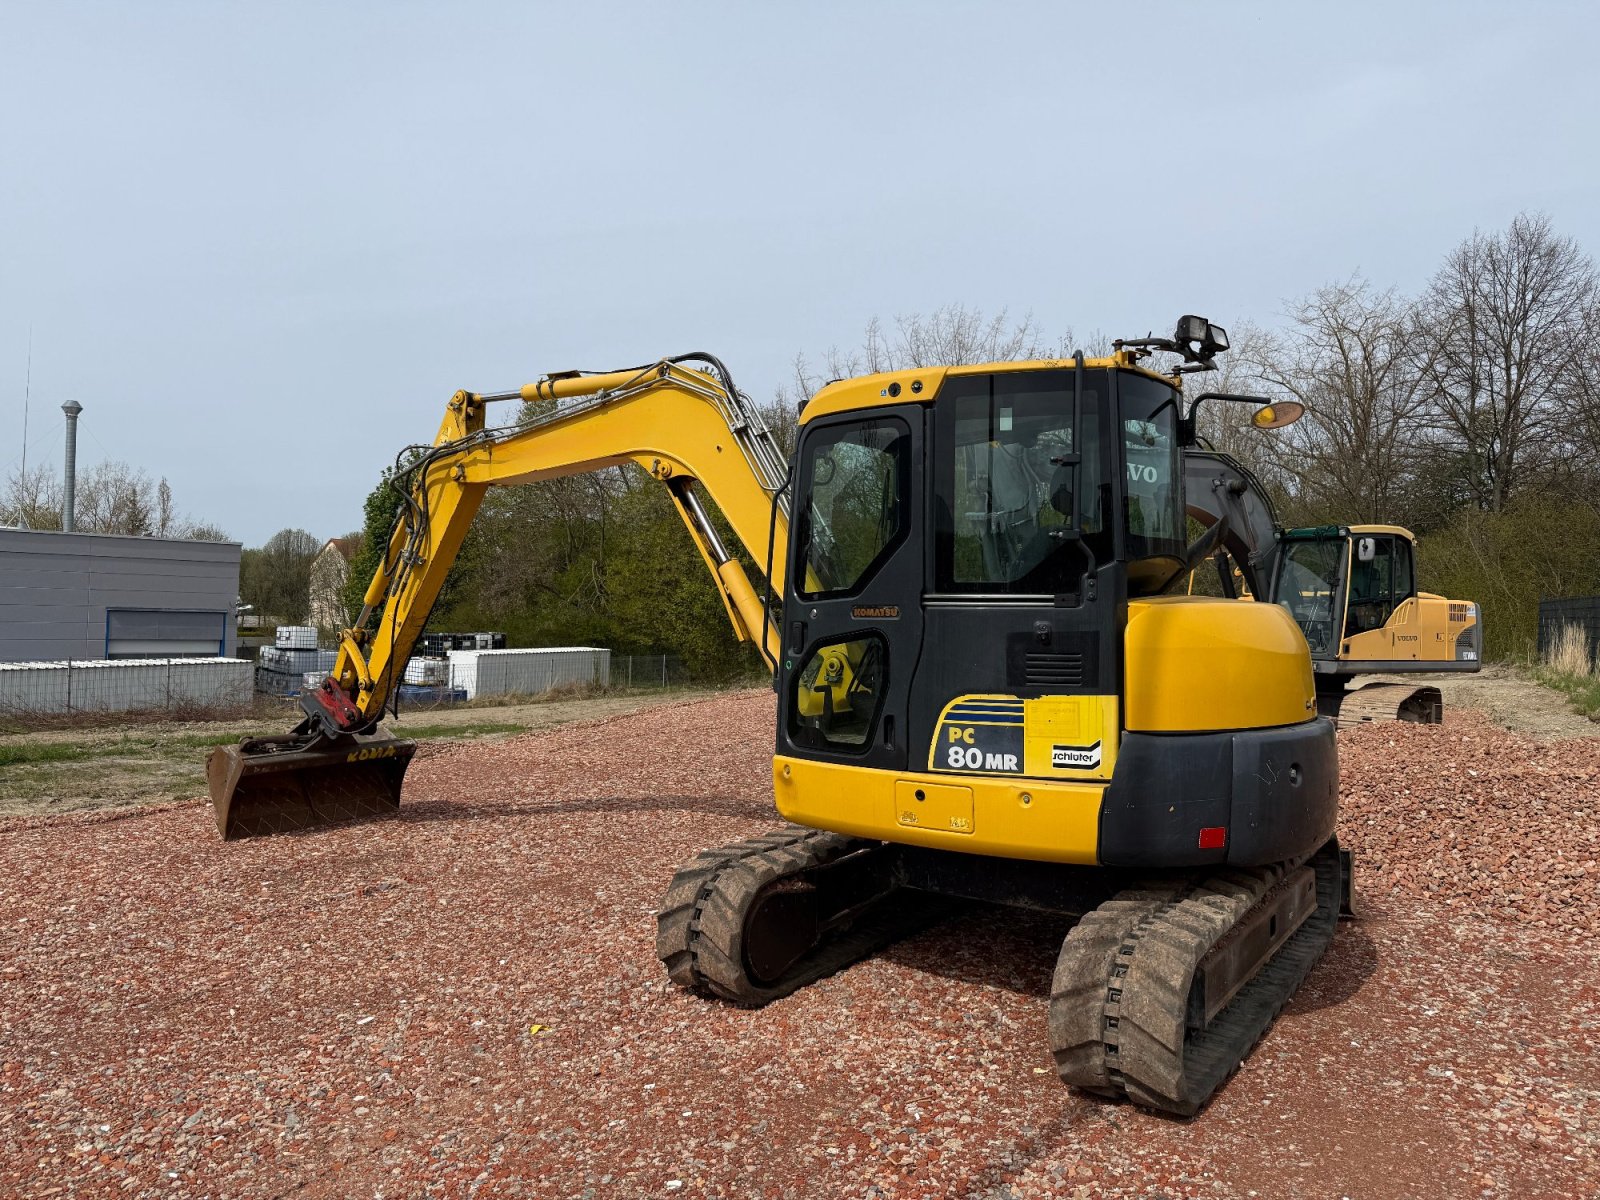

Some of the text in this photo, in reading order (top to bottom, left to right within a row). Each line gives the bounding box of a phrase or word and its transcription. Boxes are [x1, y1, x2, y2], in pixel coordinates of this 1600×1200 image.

[1127, 462, 1158, 483] VO
[854, 608, 898, 617] KOMATSU
[948, 726, 975, 744] PC
[948, 746, 1019, 771] 80 MR
